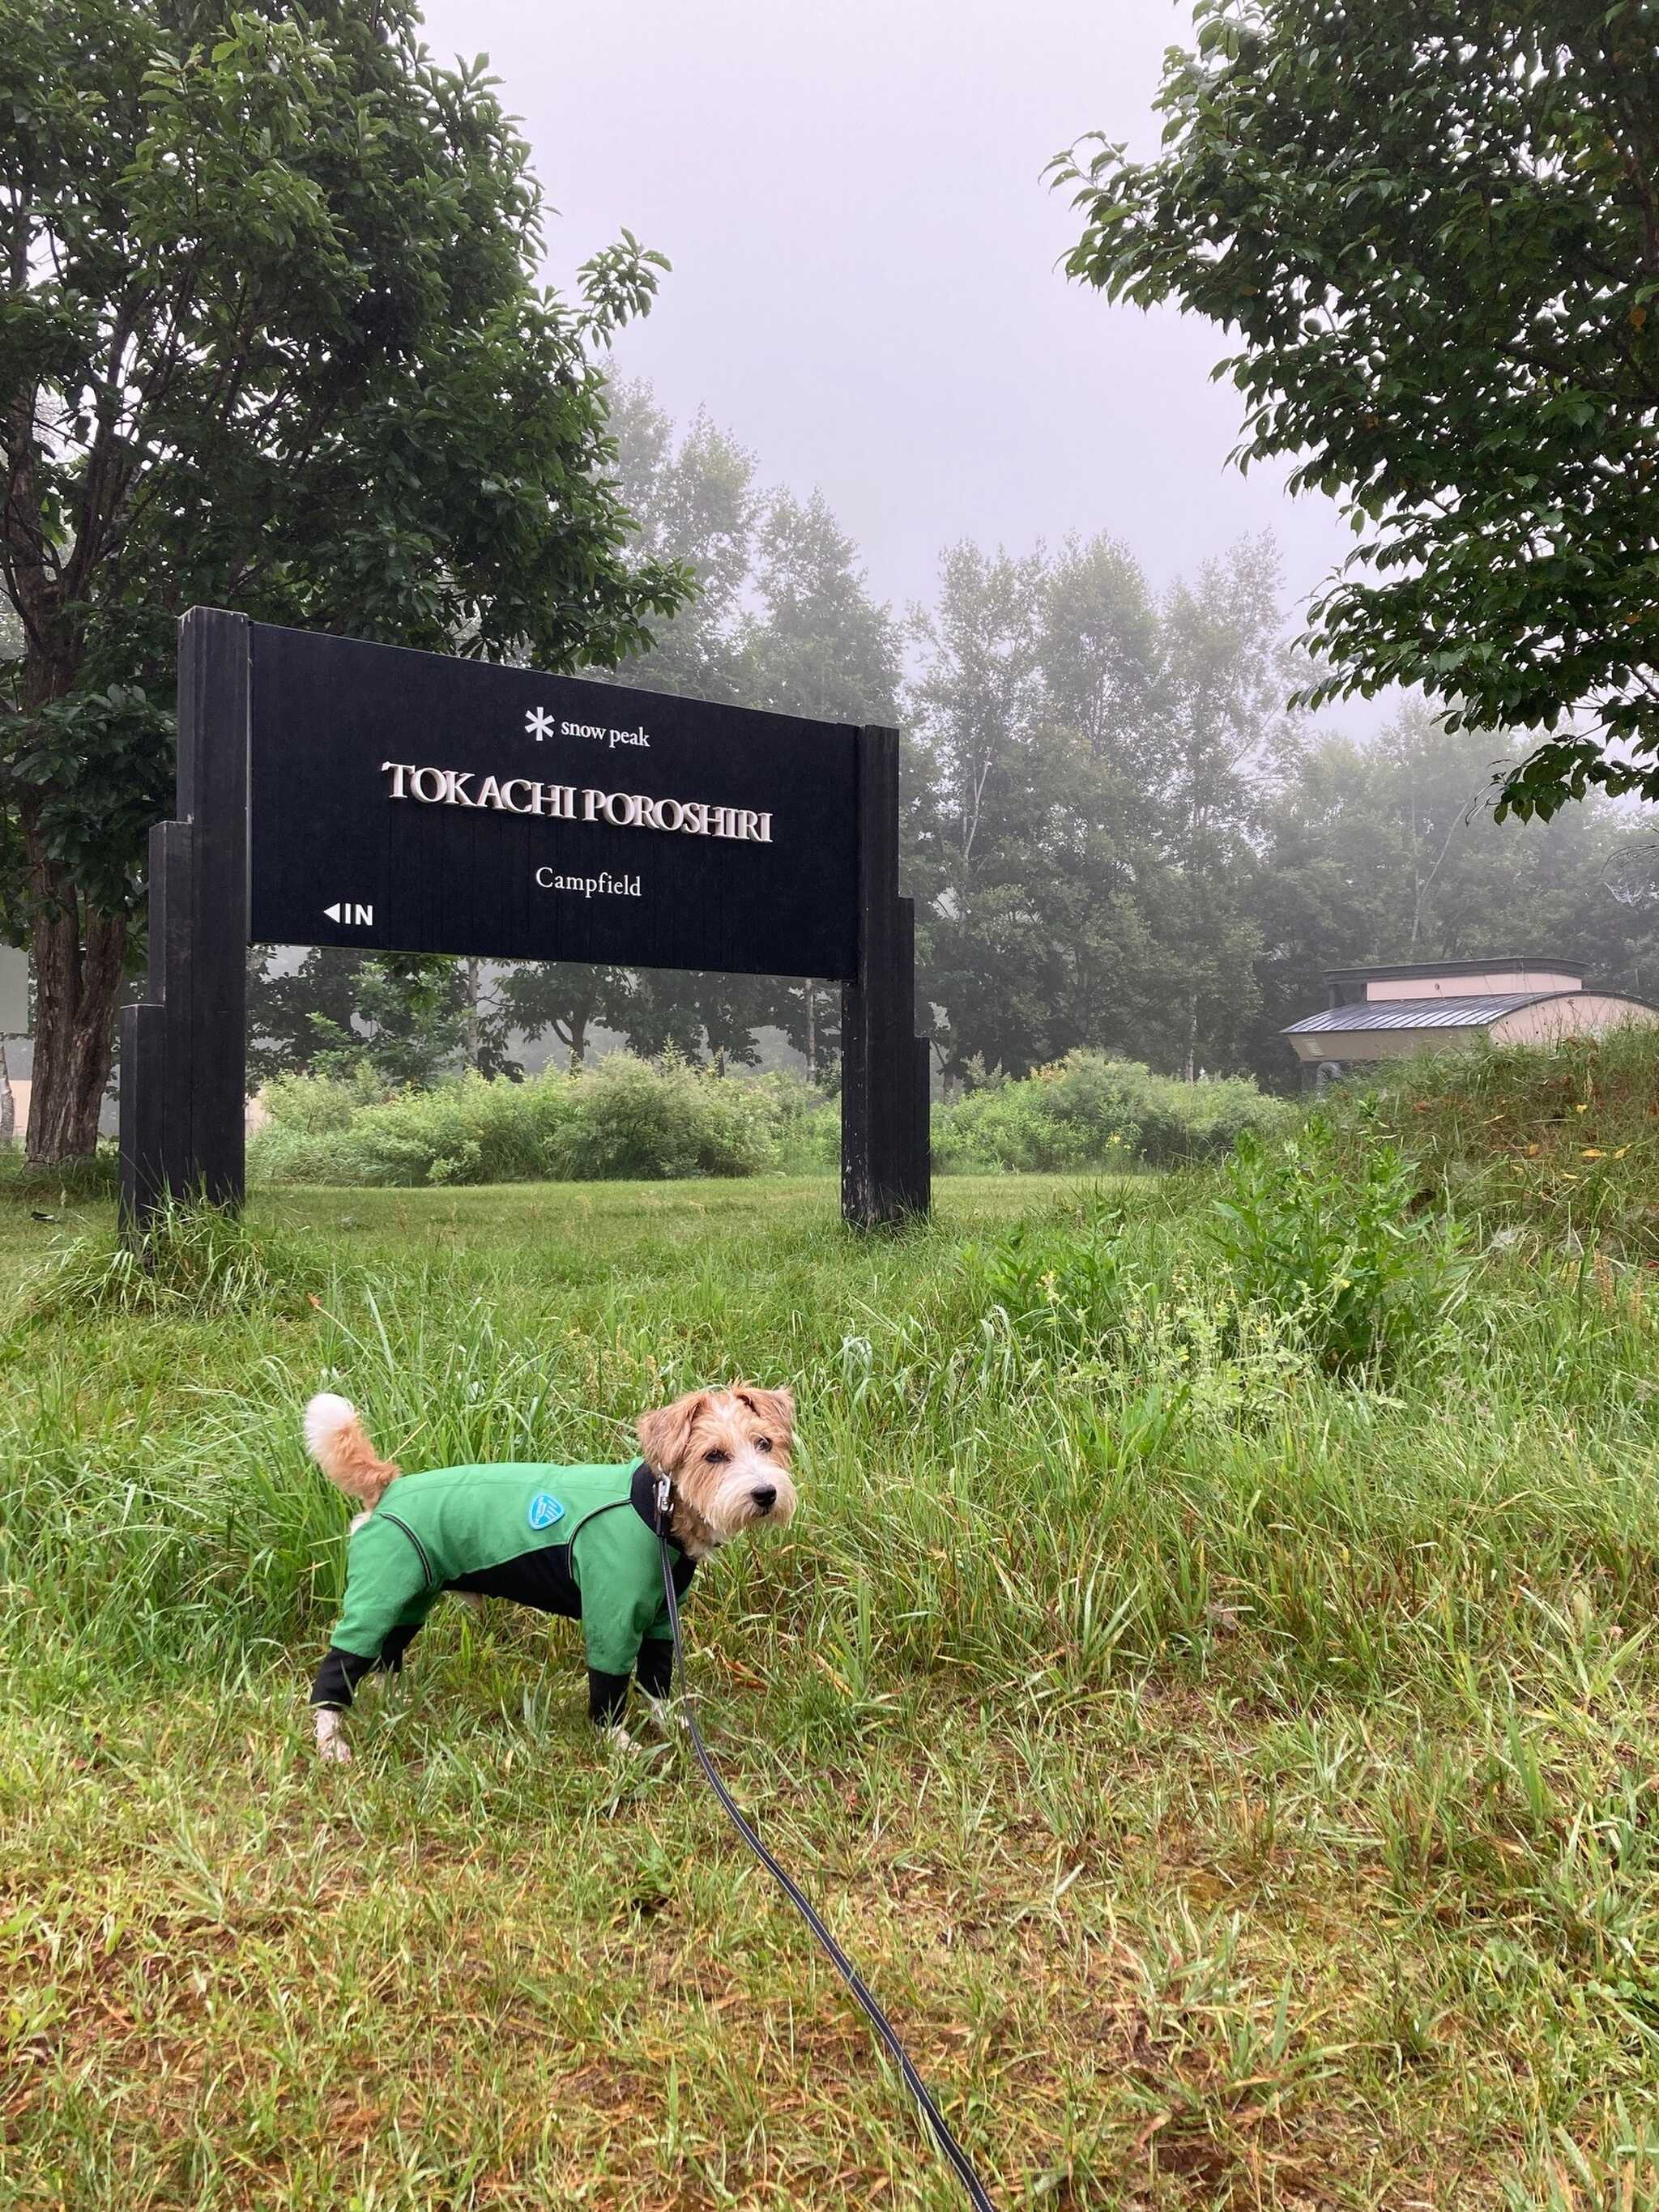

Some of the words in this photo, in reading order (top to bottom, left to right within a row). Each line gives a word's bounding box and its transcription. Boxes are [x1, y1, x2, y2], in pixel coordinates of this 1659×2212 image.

[561, 721, 607, 740] snow
[609, 726, 651, 749] peak
[382, 761, 578, 820] TOKACHI
[581, 788, 774, 843] POROSHIRI
[535, 866, 642, 899] Campfield
[344, 902, 373, 927] IN
